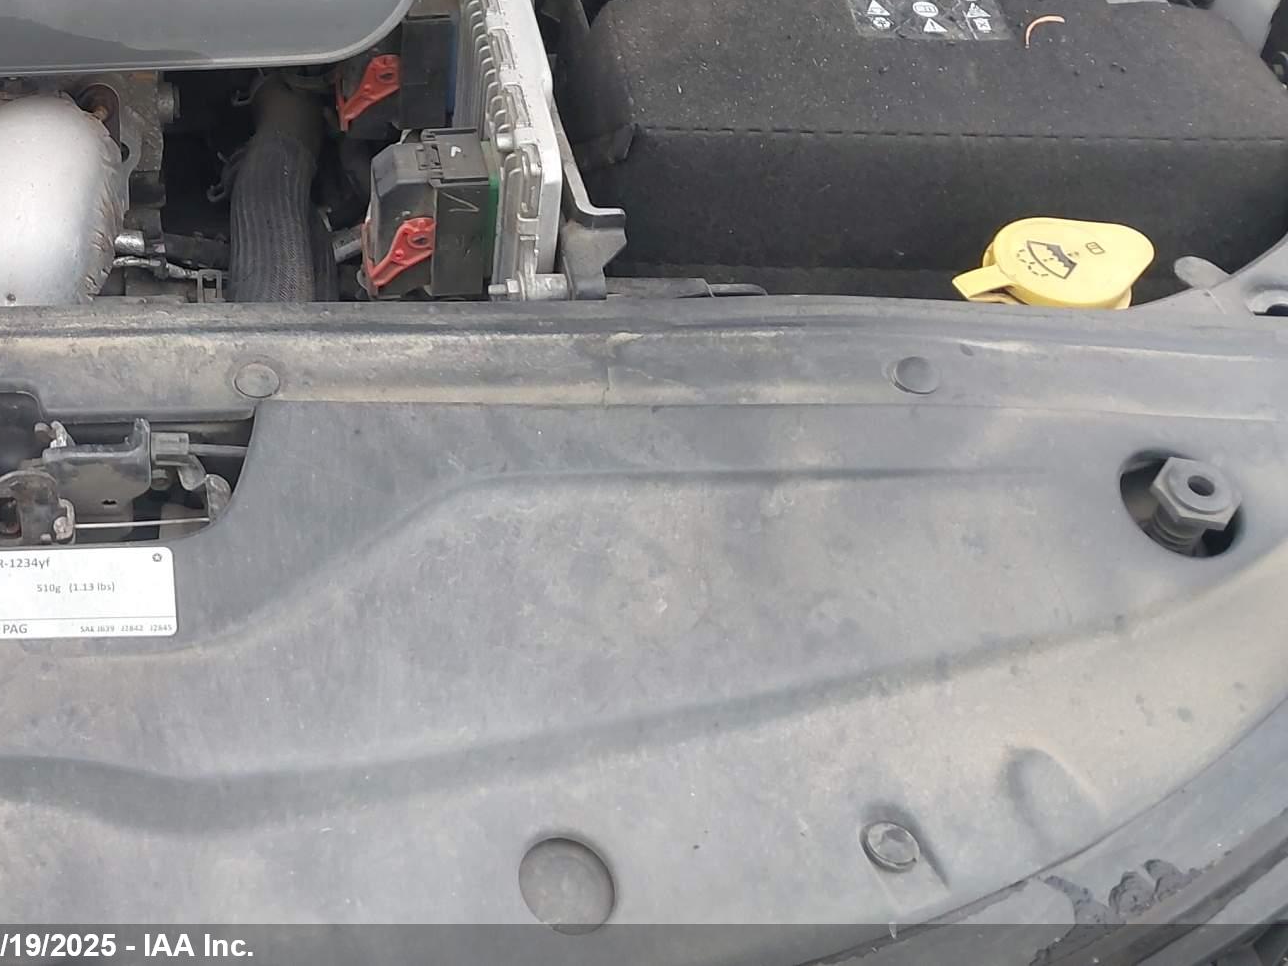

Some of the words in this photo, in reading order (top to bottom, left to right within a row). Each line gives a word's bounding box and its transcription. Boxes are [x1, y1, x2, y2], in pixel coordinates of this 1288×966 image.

[35, 583, 62, 595] 510g
[68, 582, 94, 594] (1.13
[97, 581, 116, 593] lbs)
[2, 623, 29, 635] PAG
